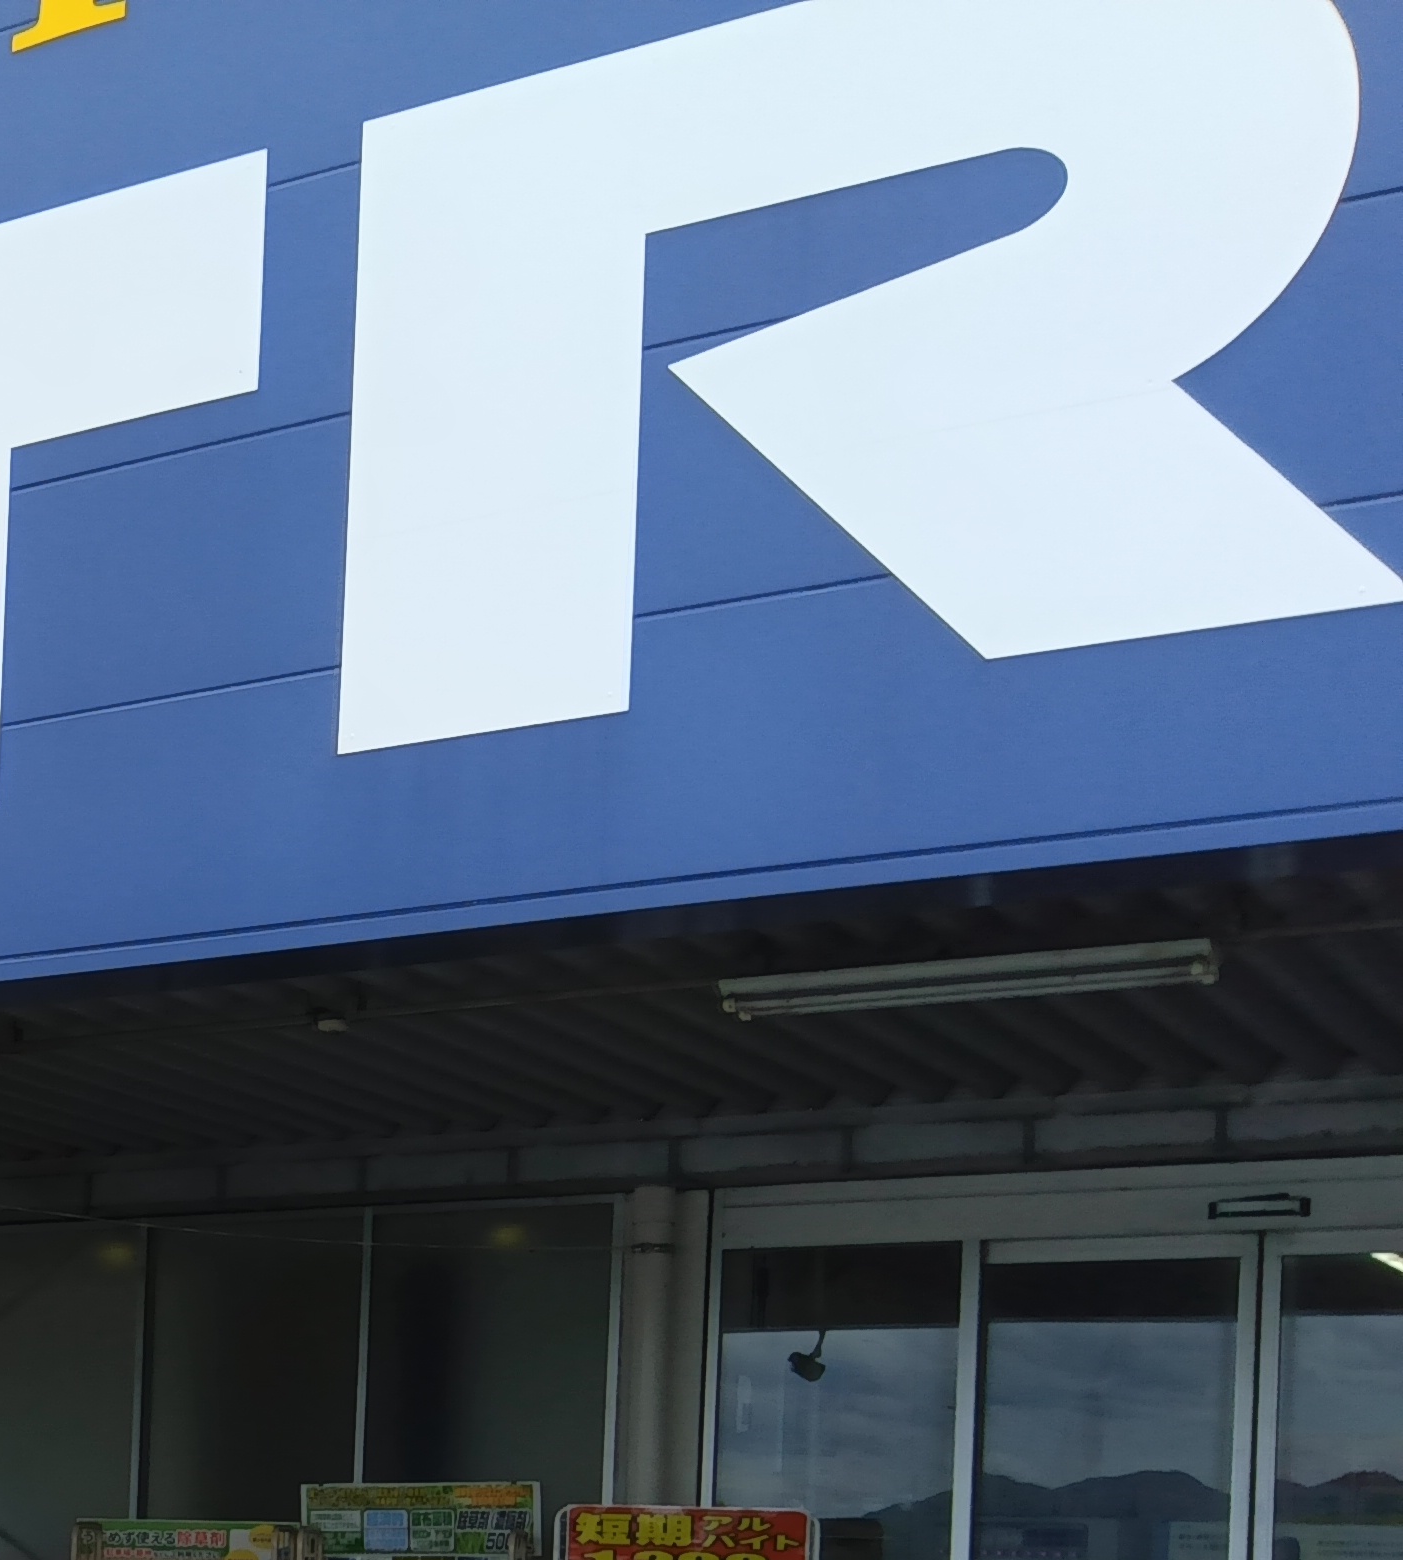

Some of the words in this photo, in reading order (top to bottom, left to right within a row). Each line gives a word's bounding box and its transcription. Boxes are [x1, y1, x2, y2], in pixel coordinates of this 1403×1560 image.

[575, 1511, 692, 1547] 短期
[701, 1514, 772, 1532] アル
[80, 1530, 225, 1547] うめず使える除草剤
[701, 1533, 799, 1551] バイト
